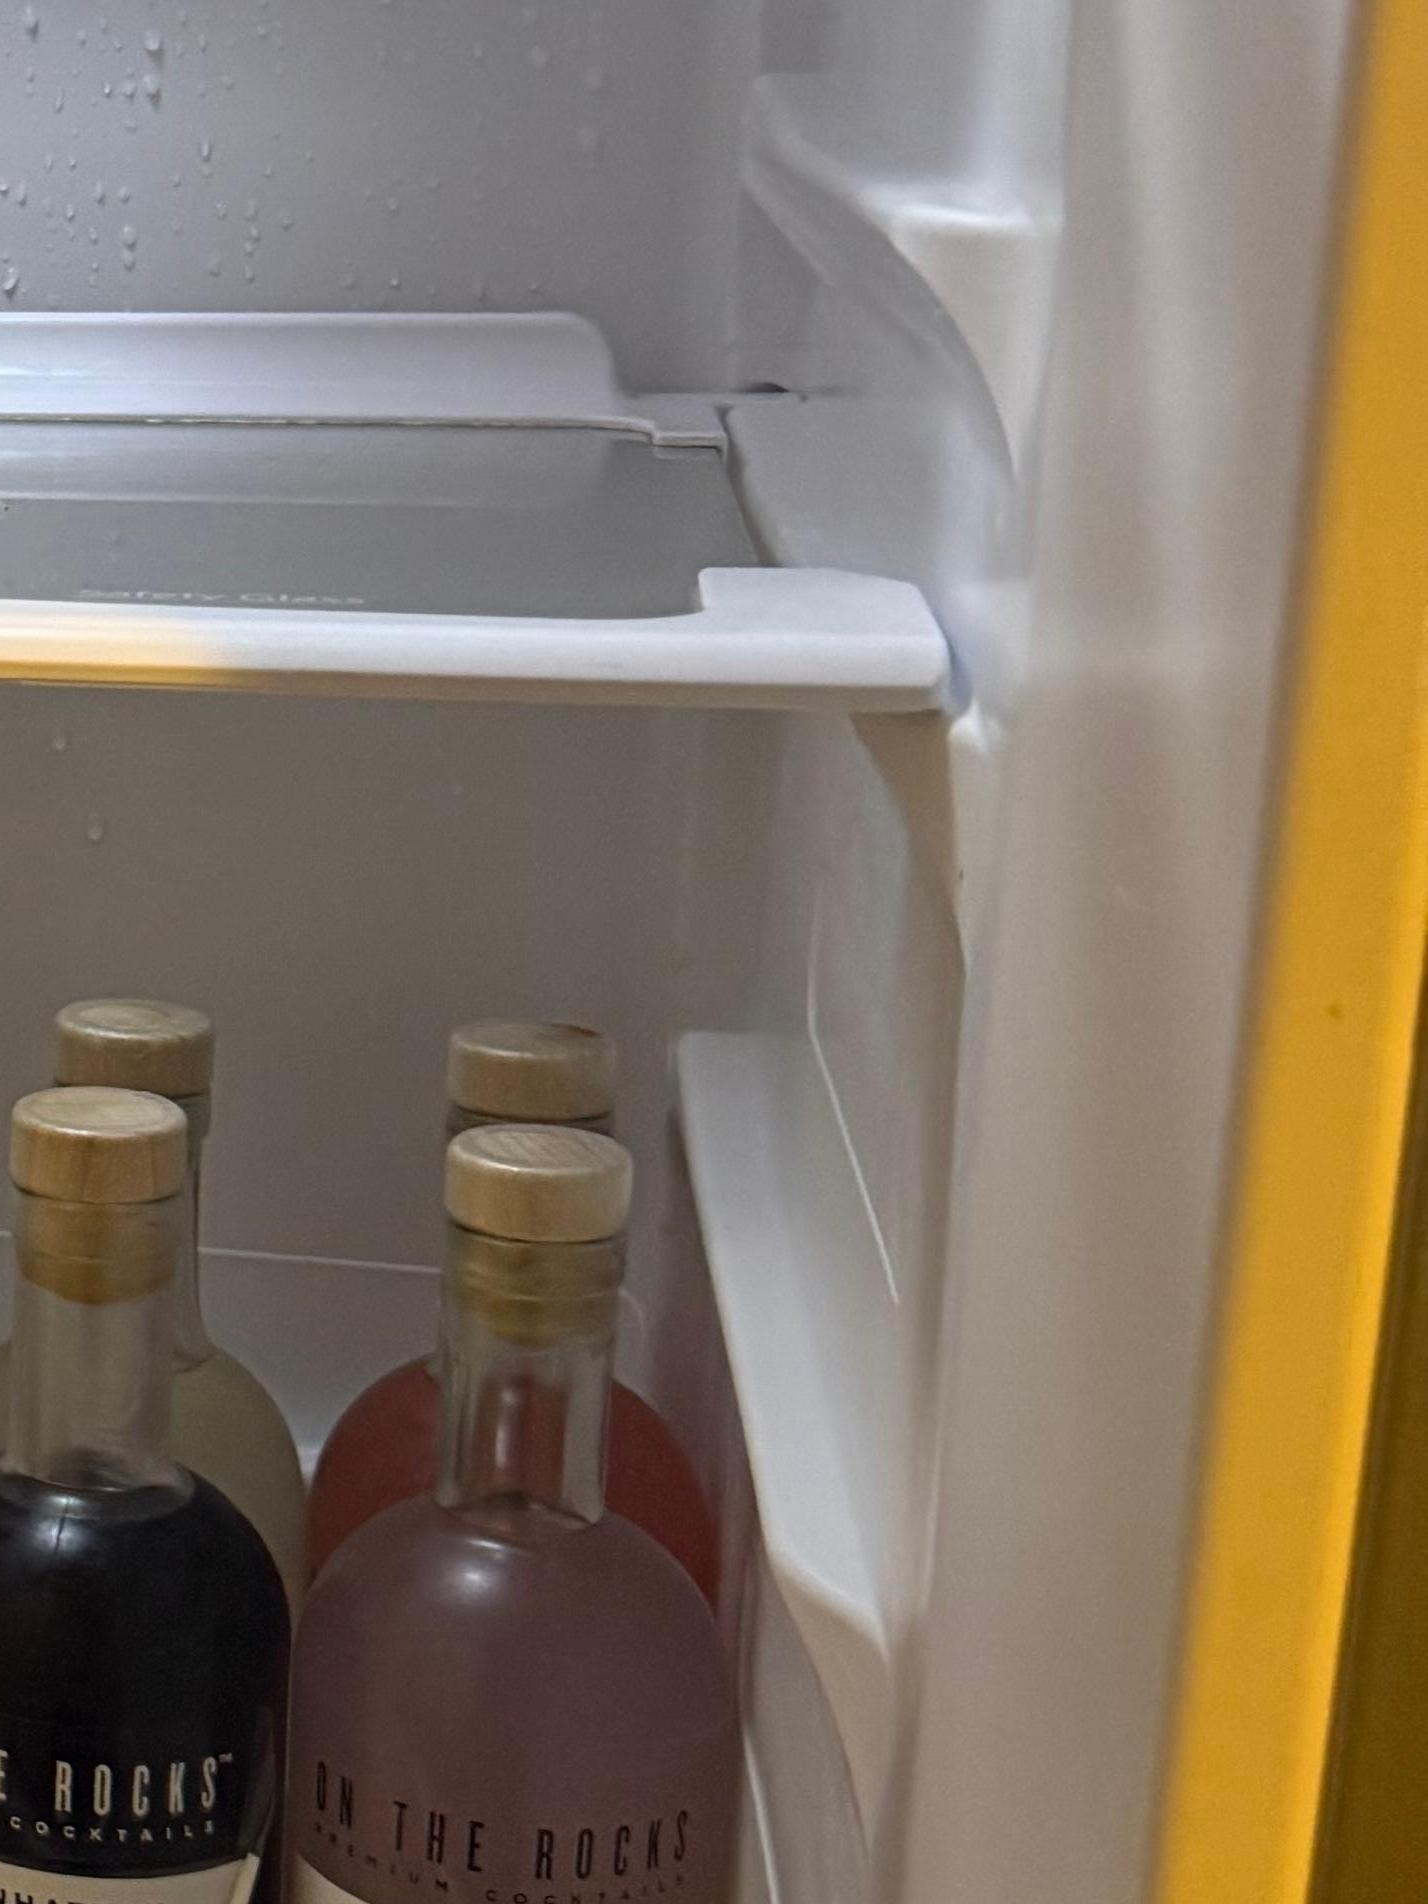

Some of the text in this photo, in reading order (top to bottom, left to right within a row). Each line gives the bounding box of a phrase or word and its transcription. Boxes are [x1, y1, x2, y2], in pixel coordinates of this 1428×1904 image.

[9, 1814, 215, 1844] COCKTAILS
[315, 1760, 689, 1882] ON THE ROCKS
